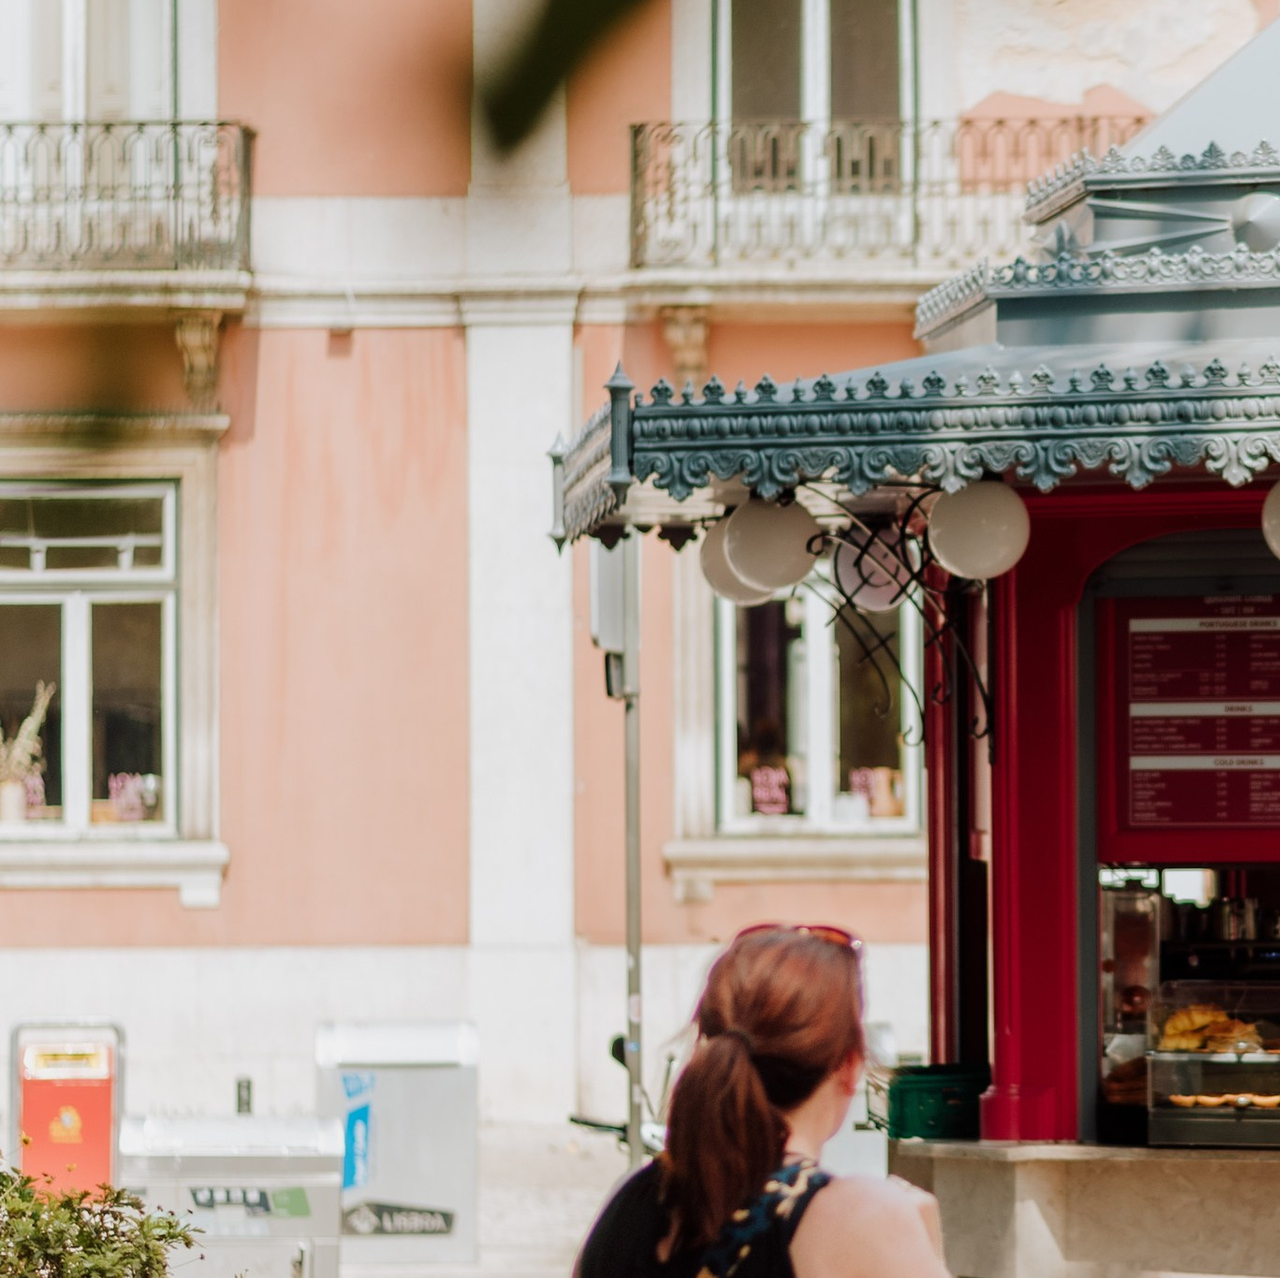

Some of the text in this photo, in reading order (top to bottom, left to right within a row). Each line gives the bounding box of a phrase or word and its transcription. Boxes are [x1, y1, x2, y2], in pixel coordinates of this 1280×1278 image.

[1199, 620, 1247, 628] PORTUGUESE
[1225, 705, 1253, 713] DRINKS
[1236, 758, 1264, 766] DRINKS
[382, 1211, 448, 1233] LISBOA
